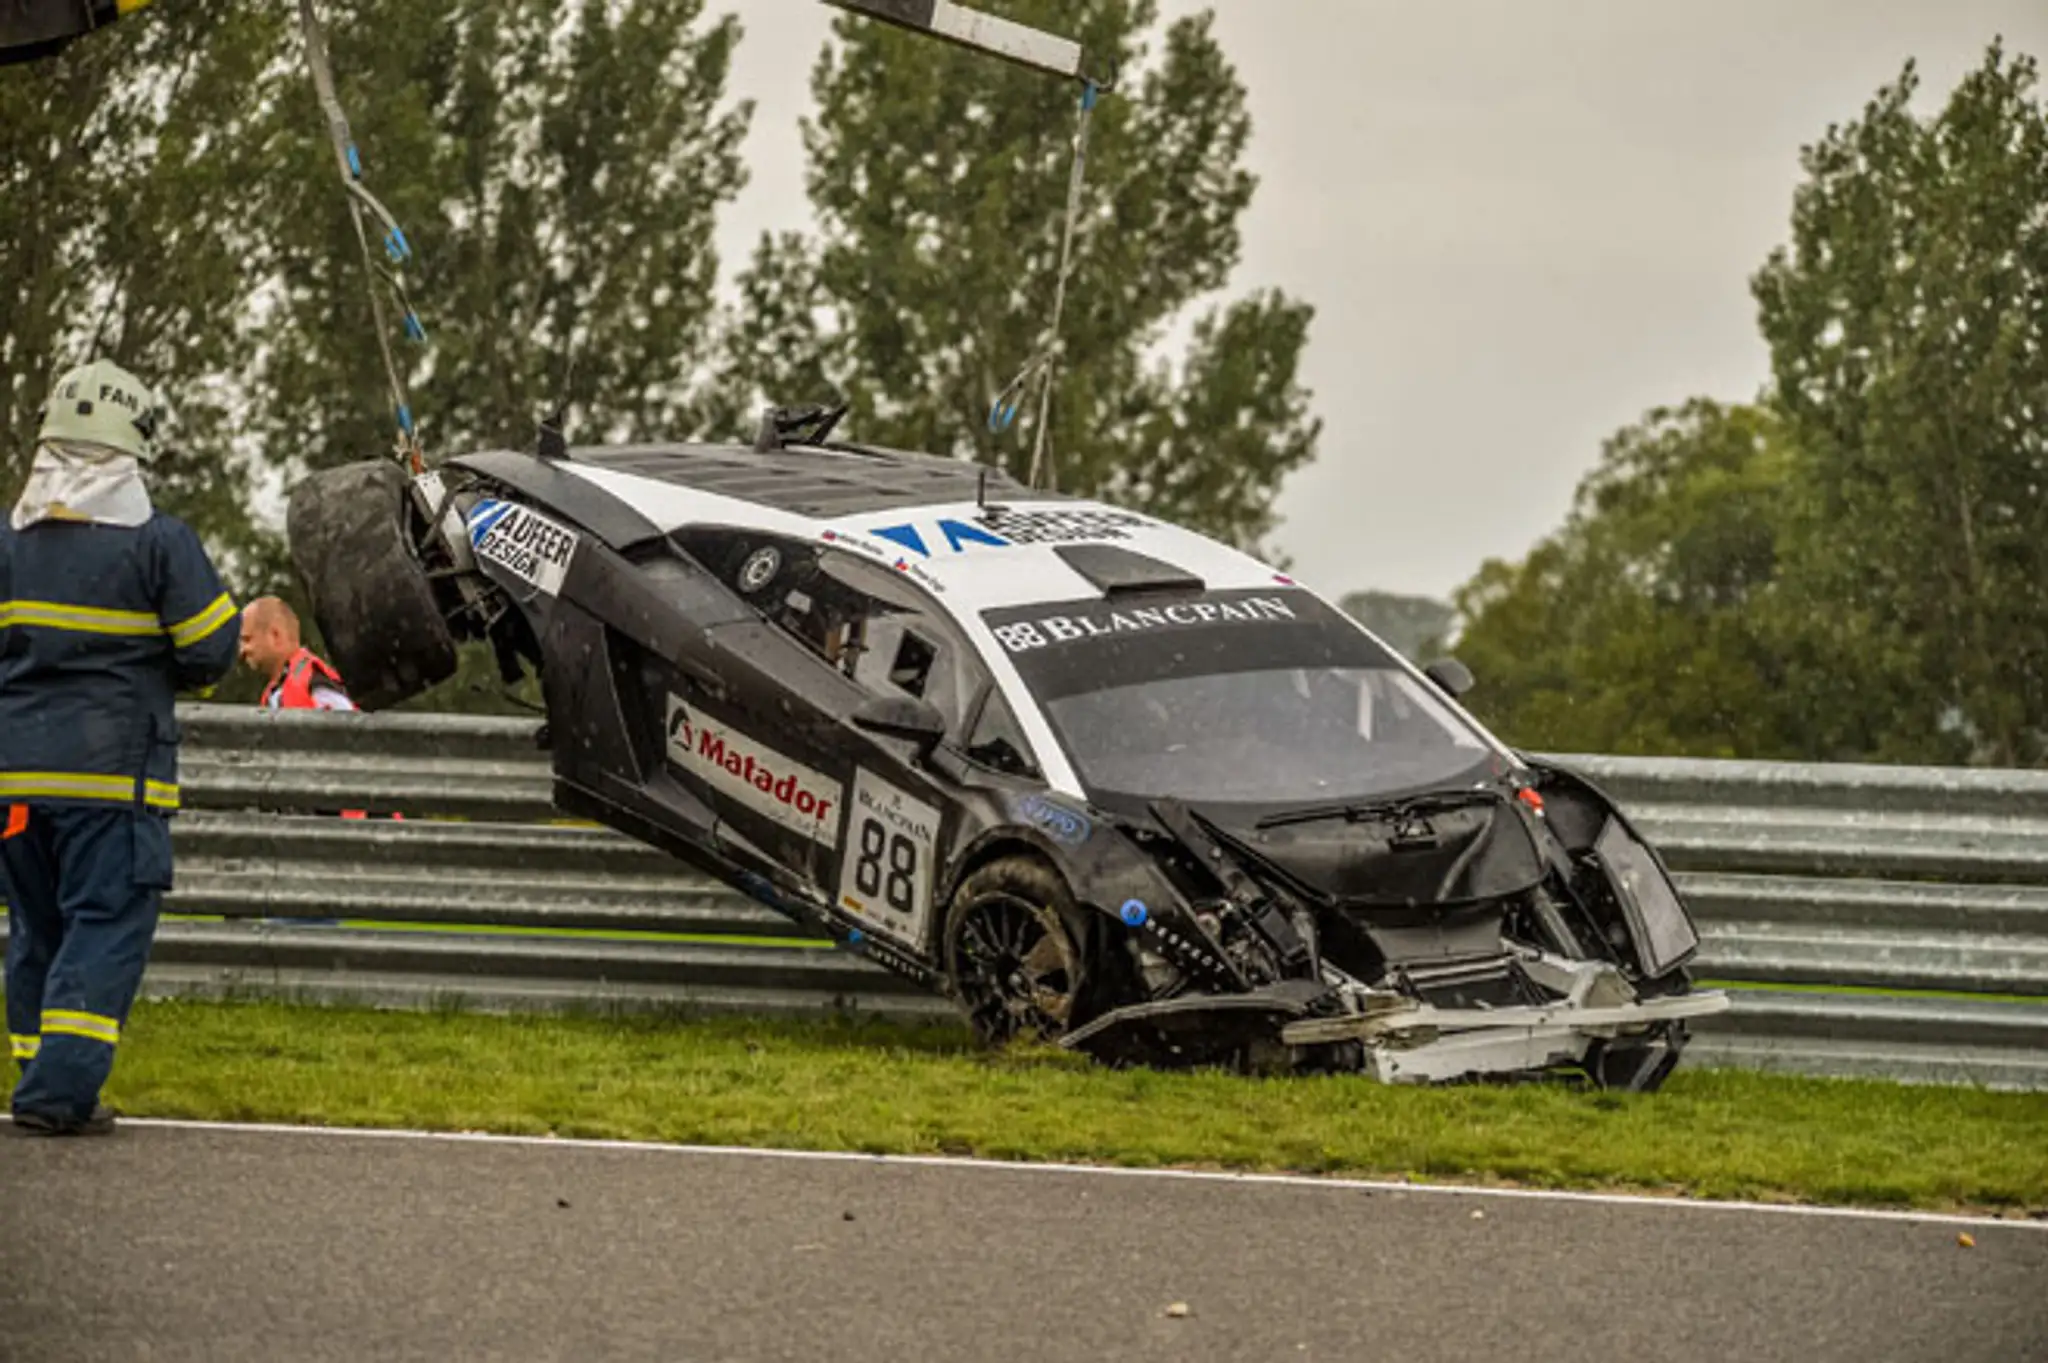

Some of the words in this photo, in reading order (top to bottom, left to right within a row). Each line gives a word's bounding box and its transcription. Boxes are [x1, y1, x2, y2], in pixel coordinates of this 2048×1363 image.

[479, 531, 541, 578] DESIGN
[994, 621, 1047, 652] 88
[1045, 597, 1297, 641] BLANCPAIN
[698, 728, 833, 821] Matador
[855, 817, 917, 913] 88
